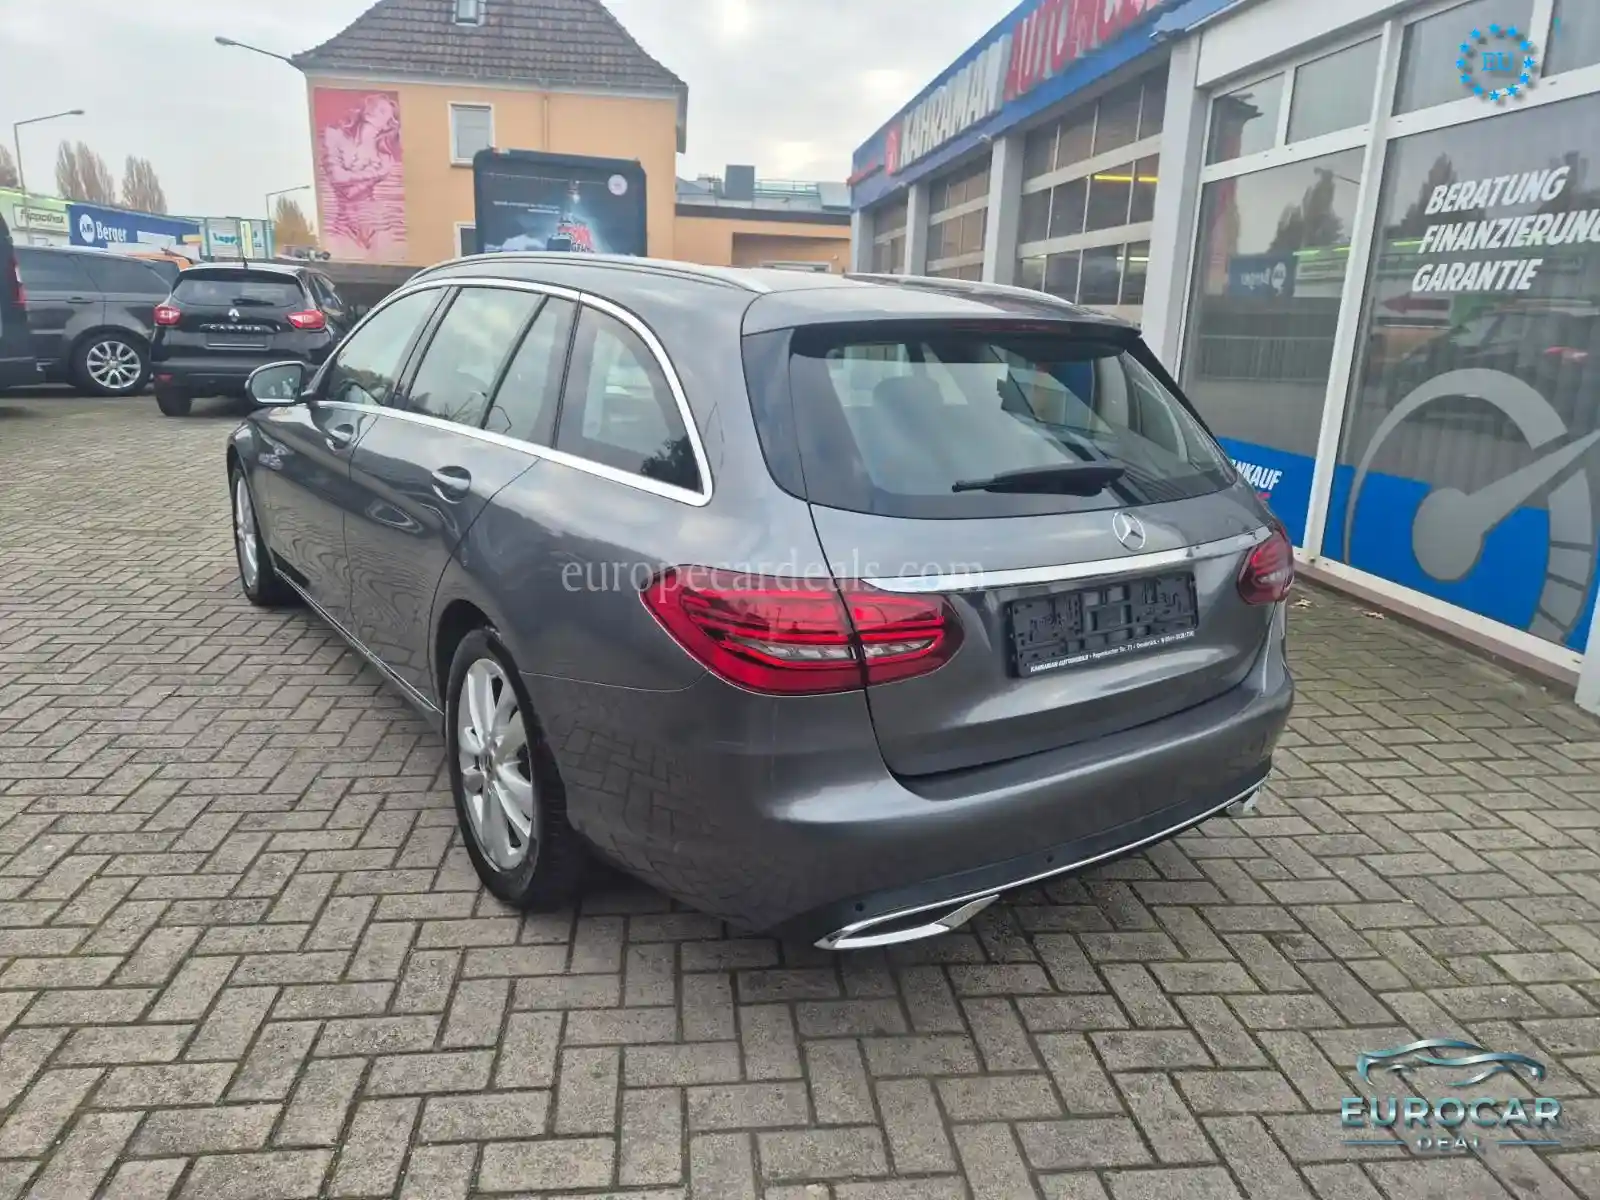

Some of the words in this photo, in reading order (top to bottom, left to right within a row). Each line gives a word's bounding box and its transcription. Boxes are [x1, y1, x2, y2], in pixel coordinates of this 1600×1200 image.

[900, 34, 1010, 167] KAHRAMAN
[1003, 0, 1162, 101] AUTOM
[1424, 165, 1571, 215] BERATUNG
[95, 220, 127, 242] Berger
[1412, 258, 1544, 293] GARANTIE
[1230, 458, 1283, 491] NKAUF
